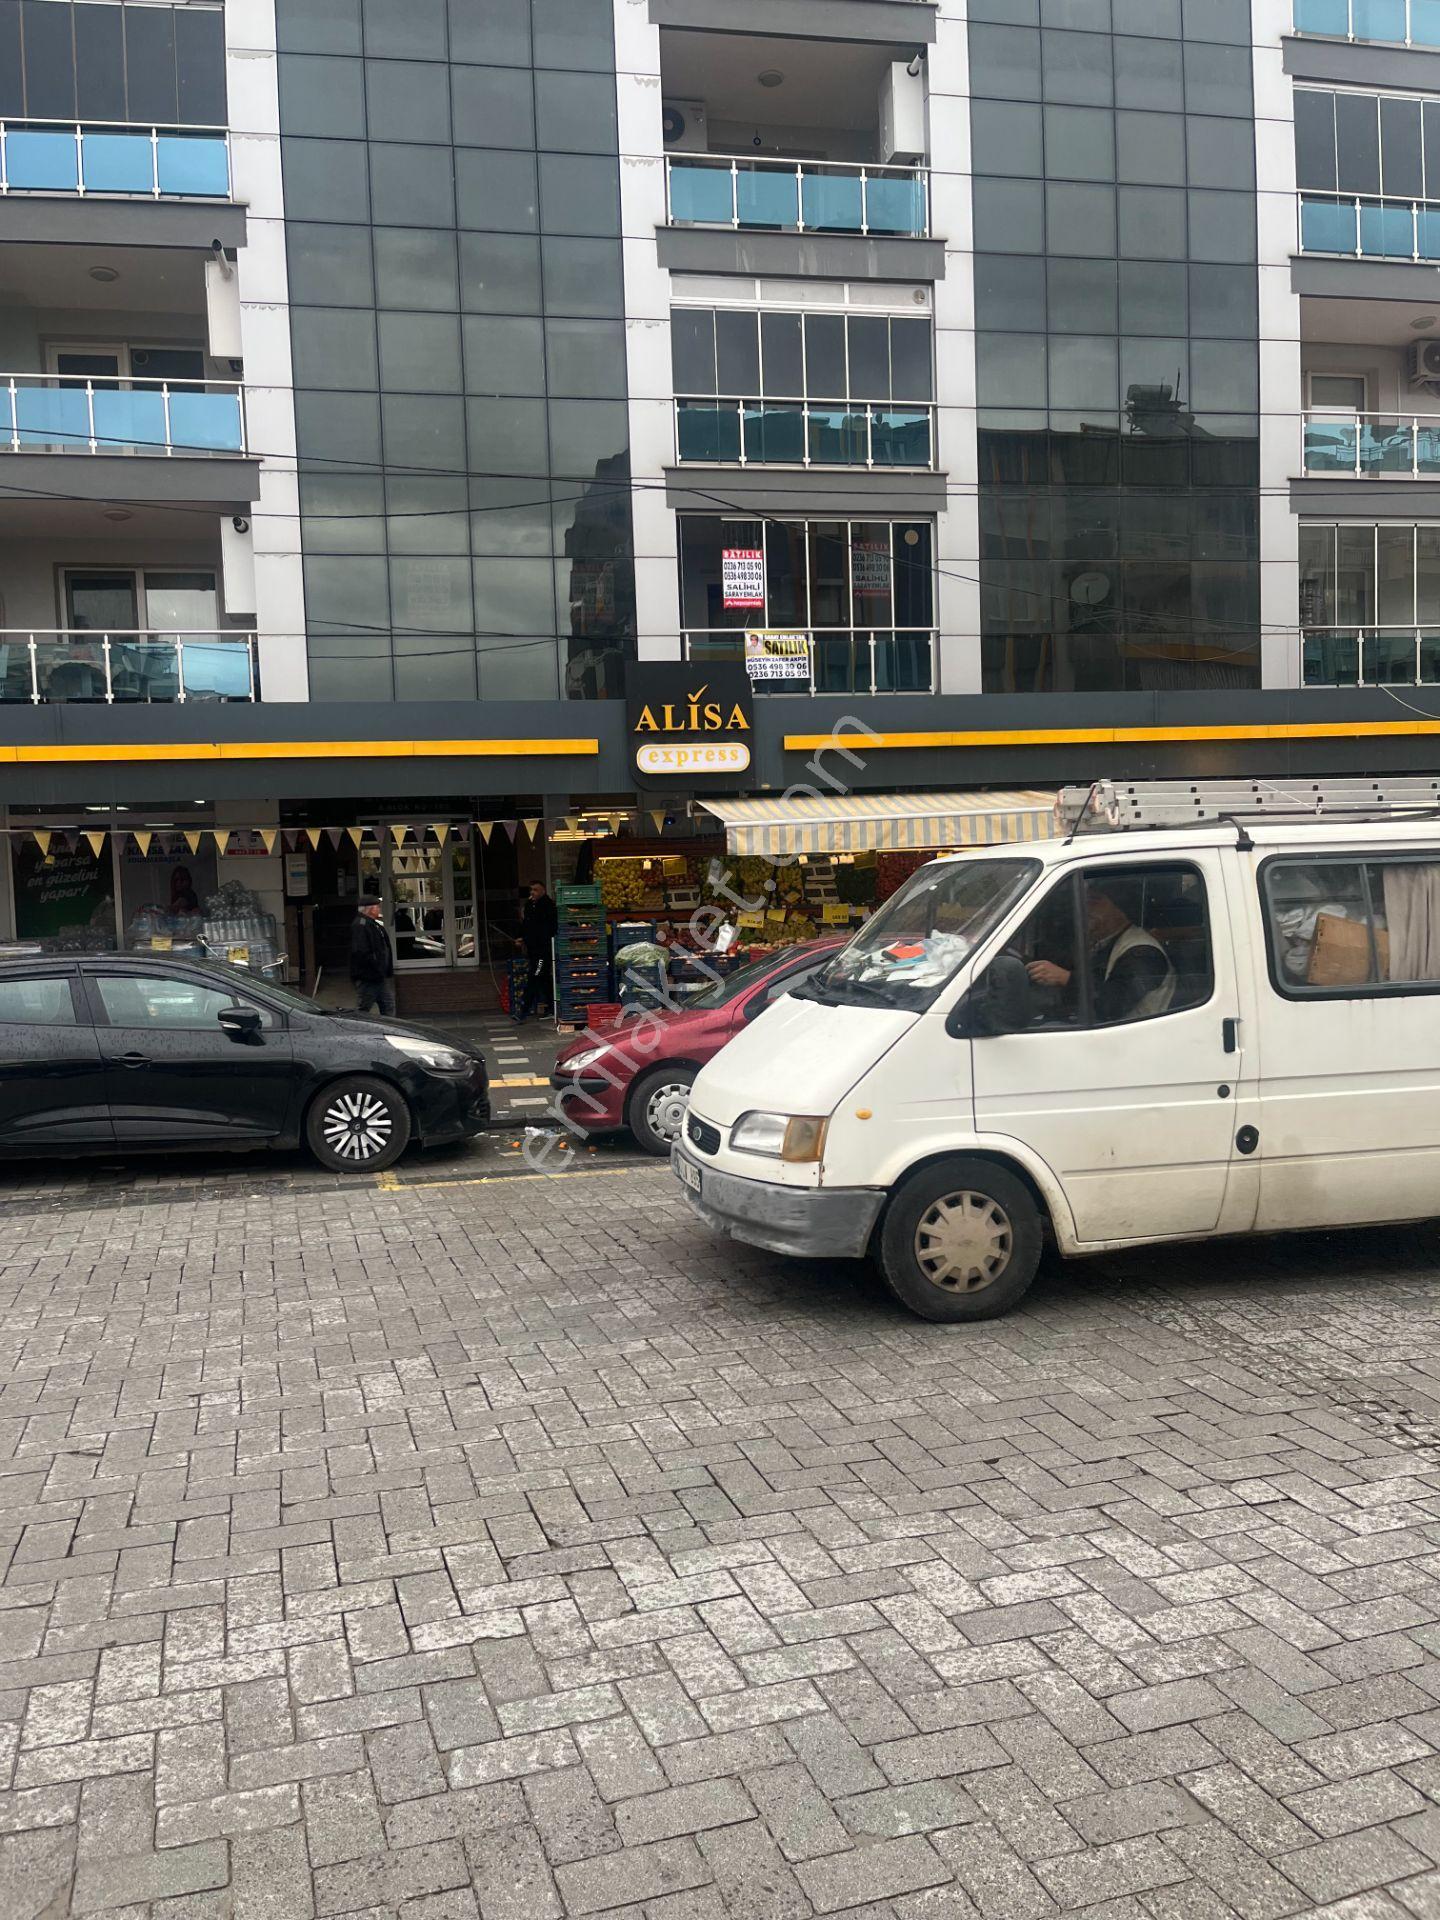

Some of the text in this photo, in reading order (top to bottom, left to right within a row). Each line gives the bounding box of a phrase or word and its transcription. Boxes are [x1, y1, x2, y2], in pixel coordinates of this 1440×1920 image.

[724, 550, 761, 558] SATILIK
[724, 561, 762, 570] 0236 713 05 90
[724, 572, 762, 580] 0536 498 30 06
[726, 583, 760, 591] SALİHLİ
[765, 640, 807, 655] SATILIK
[747, 663, 768, 671] 0536
[796, 662, 807, 670] 06
[648, 745, 739, 766] express
[26, 870, 99, 888] en güzelini
[40, 884, 89, 904] yapar!
